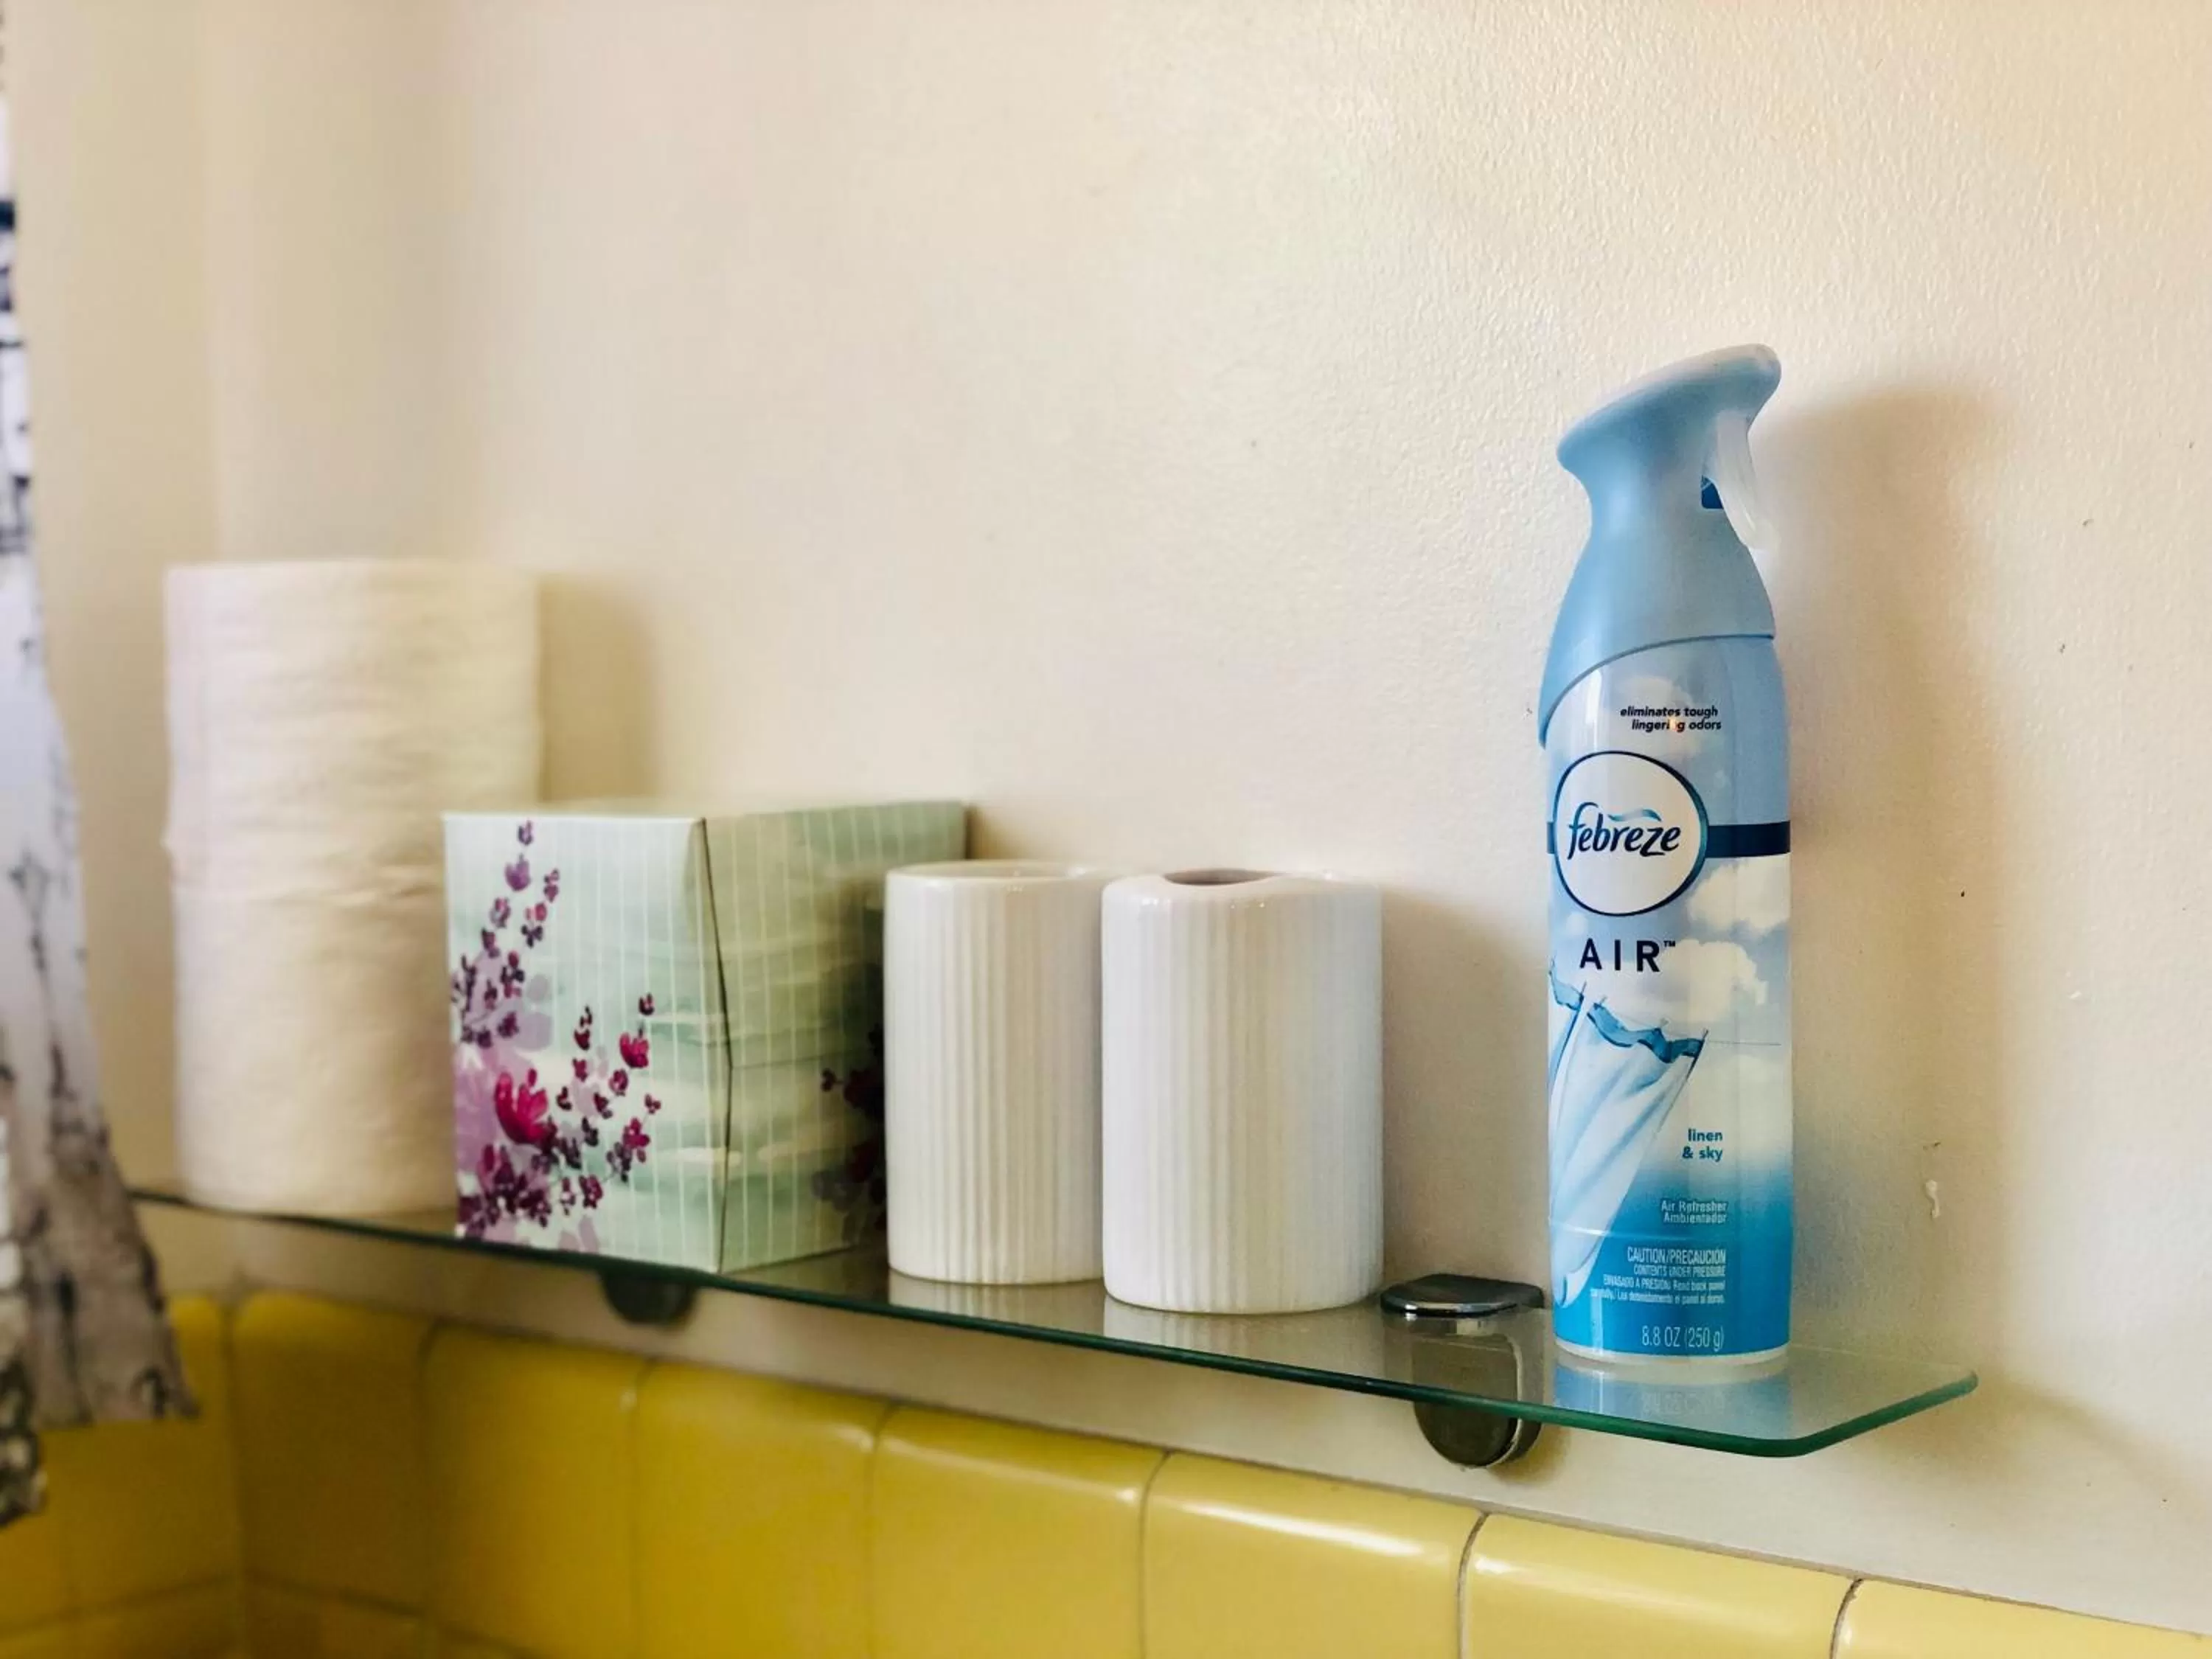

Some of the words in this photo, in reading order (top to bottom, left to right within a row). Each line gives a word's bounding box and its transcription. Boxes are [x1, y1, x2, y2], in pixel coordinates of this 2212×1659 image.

[1621, 706, 1681, 717] eliminates
[1683, 705, 1719, 719] tough
[1632, 720, 1686, 732] lingerig
[1688, 719, 1722, 730] odors
[1568, 801, 1681, 860] febreze
[1688, 1127, 1723, 1141] linen
[1682, 1146, 1693, 1159] &
[1699, 1146, 1723, 1162] sky
[1661, 1200, 1675, 1211] Air
[1641, 1325, 1661, 1346] 8.8
[1664, 1326, 1681, 1348] OZ
[1684, 1326, 1710, 1350] (250
[1713, 1325, 1725, 1352] g)
